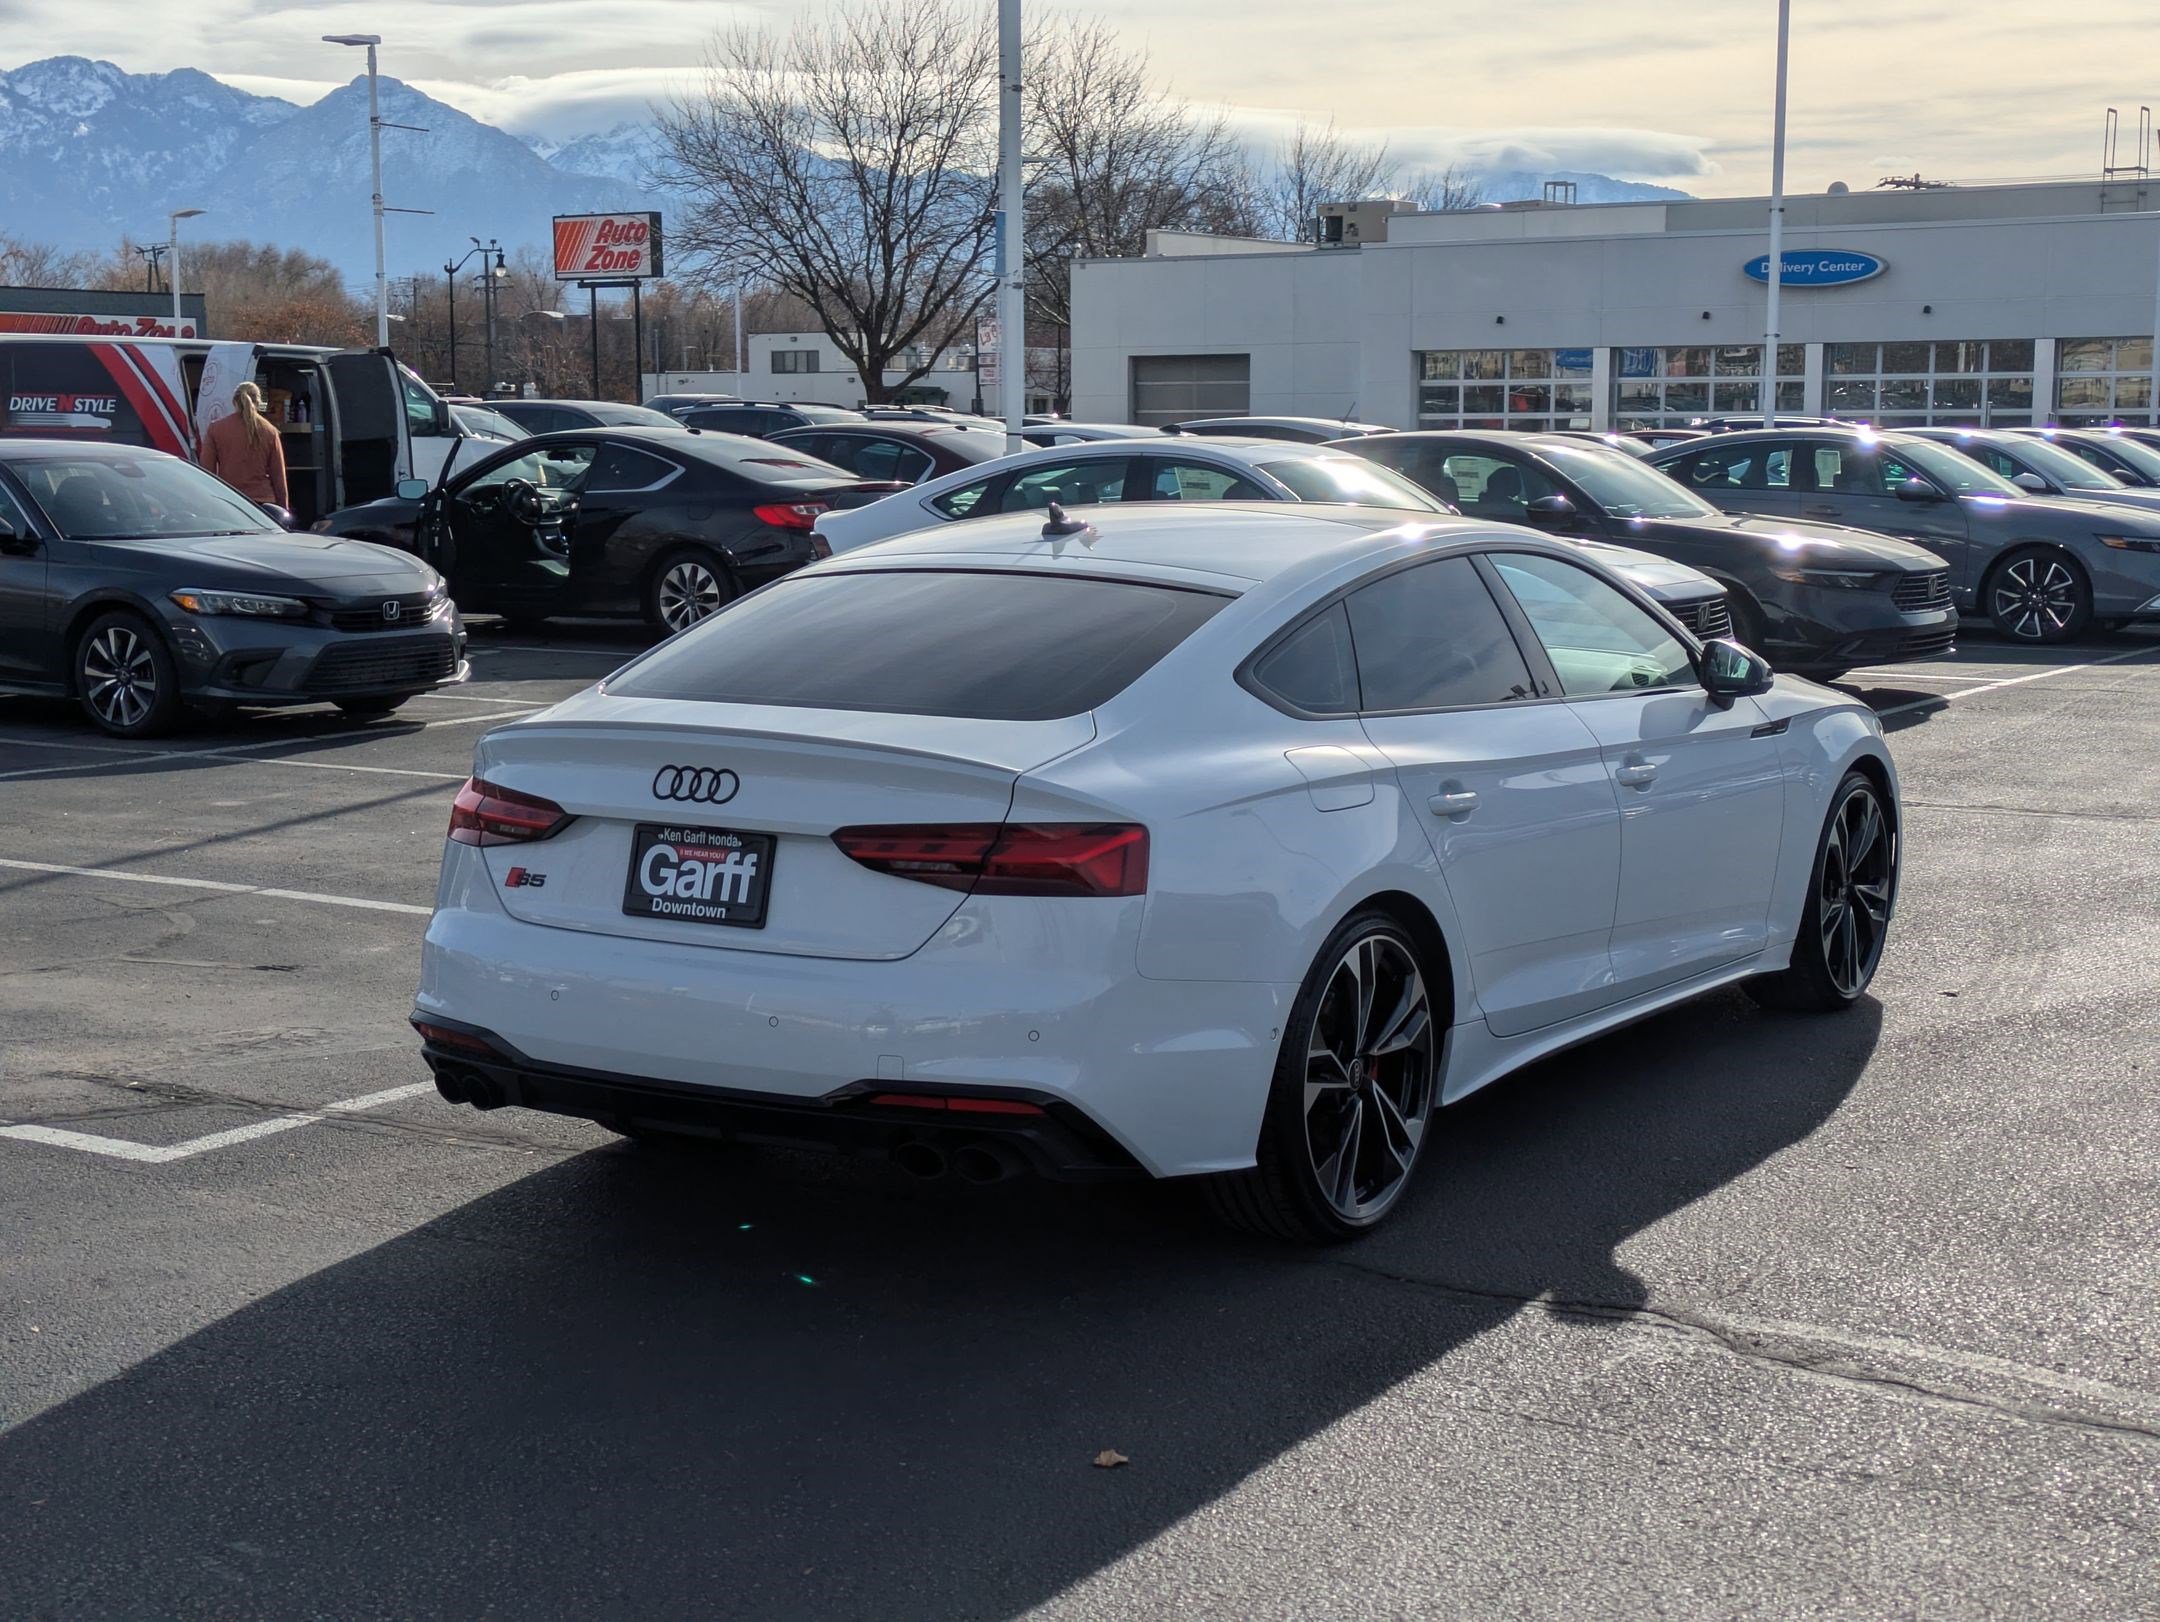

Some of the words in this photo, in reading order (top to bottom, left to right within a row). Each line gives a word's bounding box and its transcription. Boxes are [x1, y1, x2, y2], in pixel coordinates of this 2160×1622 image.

[594, 219, 648, 244] Auto
[585, 245, 641, 271] Zone
[1760, 261, 1815, 275] Dlivery
[1818, 260, 1865, 272] Center
[9, 396, 57, 411] DRIVE
[74, 398, 116, 412] STYLE
[663, 827, 681, 842] Ken
[708, 833, 738, 847] Honda
[640, 843, 758, 904] Garff
[652, 897, 726, 919] Downtown
